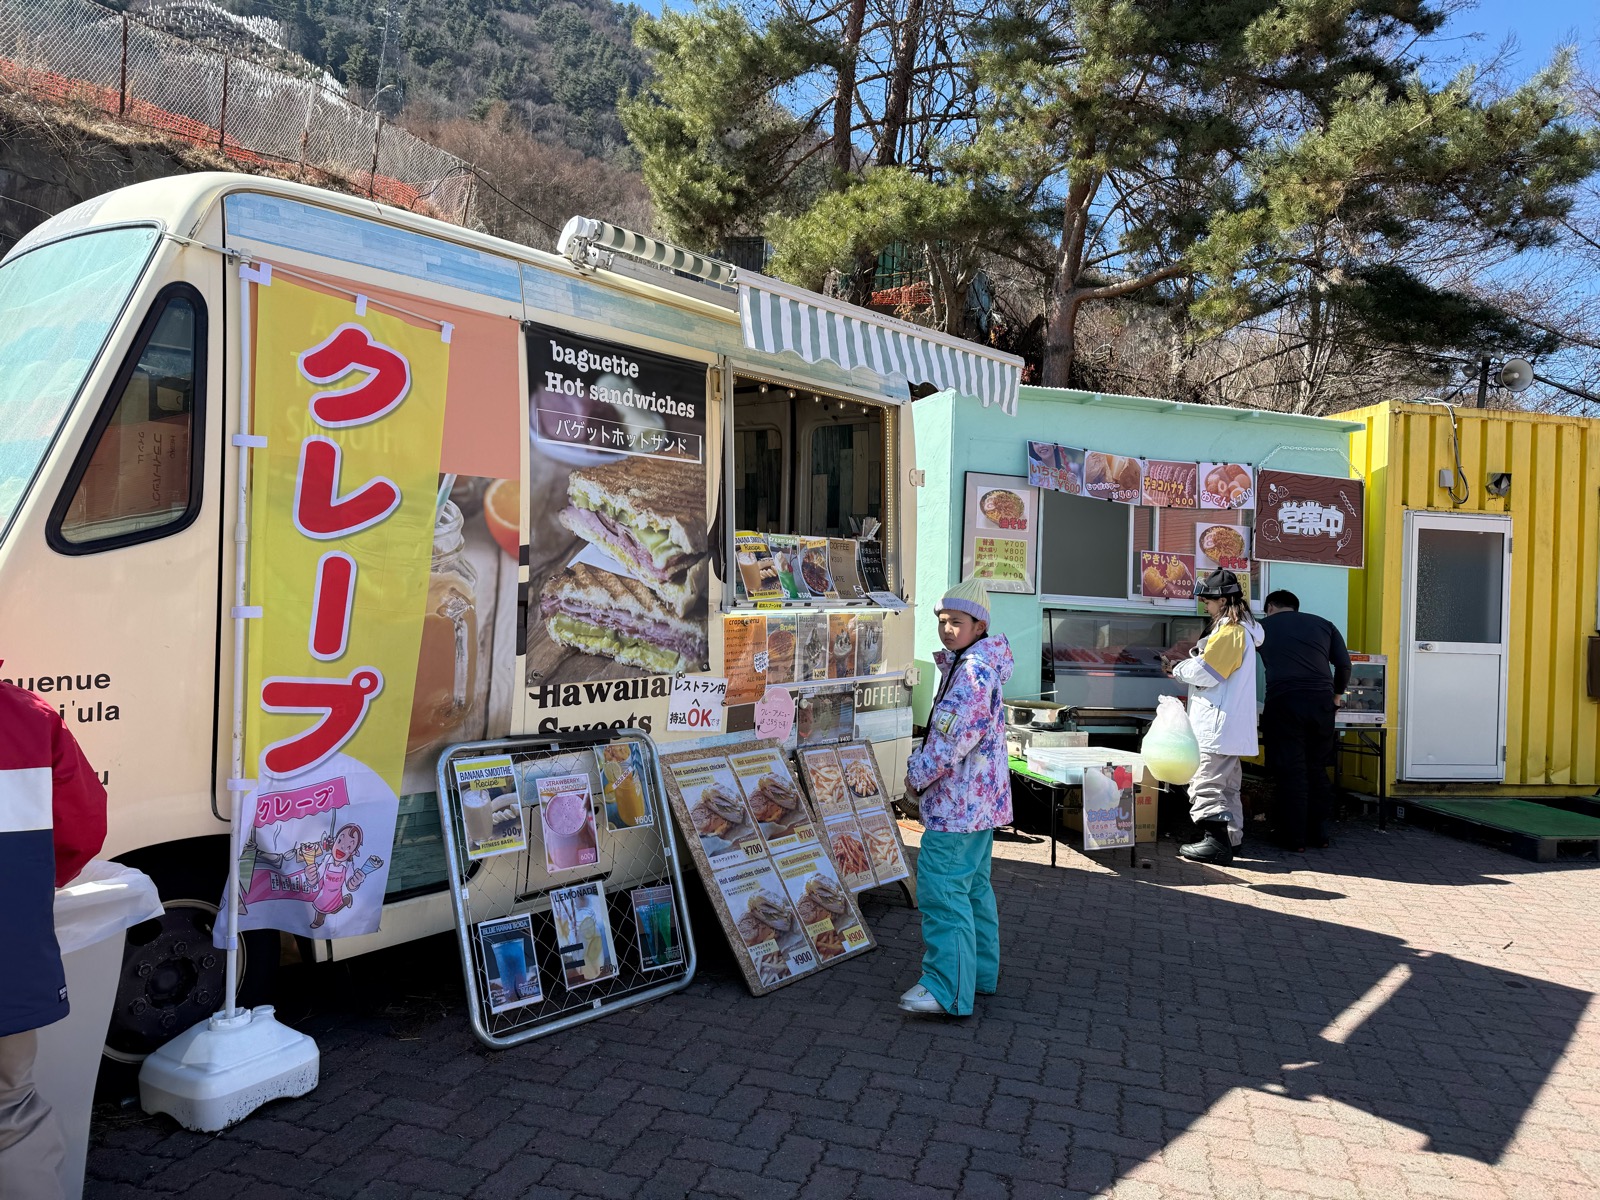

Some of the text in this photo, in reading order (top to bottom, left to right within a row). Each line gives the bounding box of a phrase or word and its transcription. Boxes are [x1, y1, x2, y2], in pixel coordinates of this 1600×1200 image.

[550, 340, 639, 378] baguette
[545, 370, 695, 418] Hot sandwiches
[555, 419, 687, 454] バゲットホットサンド
[1057, 480, 1081, 494] ¥600
[1112, 489, 1138, 500] ¥400
[1201, 490, 1229, 508] おでん
[1230, 488, 1253, 508] ¥700
[1169, 498, 1194, 506] ¥400
[999, 517, 1028, 530] 油そば
[1278, 500, 1345, 538] 営業中
[735, 536, 753, 545] ANANA
[1004, 540, 1025, 548] ¥700
[261, 322, 411, 780] クレープ
[1142, 553, 1179, 566] やきいも
[1219, 556, 1248, 569] 油そば
[2, 673, 111, 693] uenue
[674, 680, 727, 695] レストラン内
[528, 676, 673, 708] Hawaiia
[855, 684, 901, 708] COFFEE
[669, 708, 720, 728] 持込OKです
[459, 765, 513, 782] BANANA SMOOTHIE
[682, 765, 710, 775] sandwiches
[474, 778, 500, 788] Recipe
[545, 778, 580, 787] STRAWBERRY
[257, 786, 334, 822] クレープ
[1136, 796, 1152, 805] 県産
[634, 814, 653, 825] ¥600
[1087, 807, 1129, 822] わたがし
[502, 826, 522, 838] 500y
[798, 828, 815, 840] ¥700
[481, 838, 514, 849] FITNESS BASH
[744, 843, 763, 857] ¥700
[727, 870, 754, 882] sandwiches
[754, 866, 771, 875] chicken
[554, 886, 598, 902] LEMONADE
[846, 930, 865, 944] ¥900
[793, 950, 813, 966] ¥900
